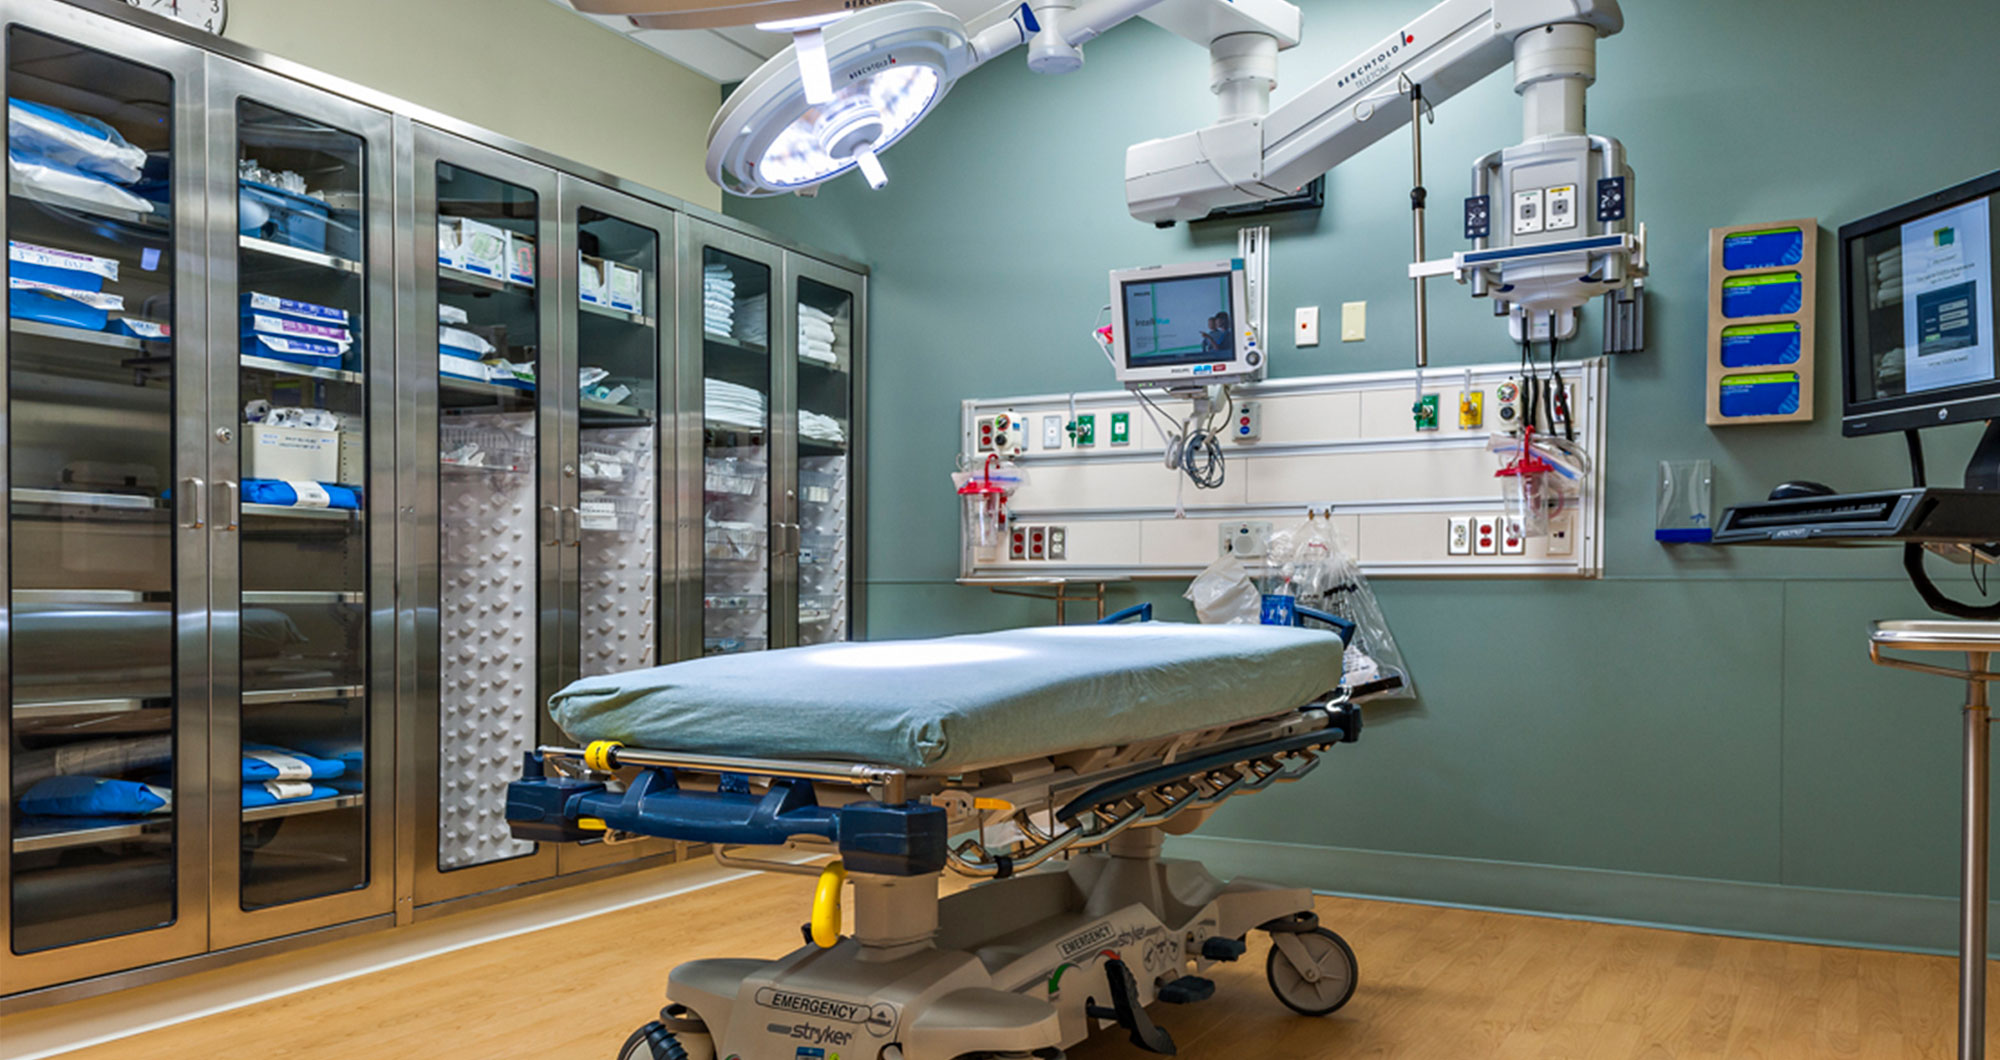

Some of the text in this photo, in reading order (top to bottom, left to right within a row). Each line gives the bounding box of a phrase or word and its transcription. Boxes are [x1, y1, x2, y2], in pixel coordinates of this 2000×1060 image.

[210, 0, 220, 14] 3
[204, 18, 214, 33] 4
[1337, 45, 1399, 88] BERCHTOLD
[1062, 925, 1110, 955] EMERGENCY
[771, 993, 858, 1020] EMERGENCY
[789, 1021, 853, 1046] stryker
